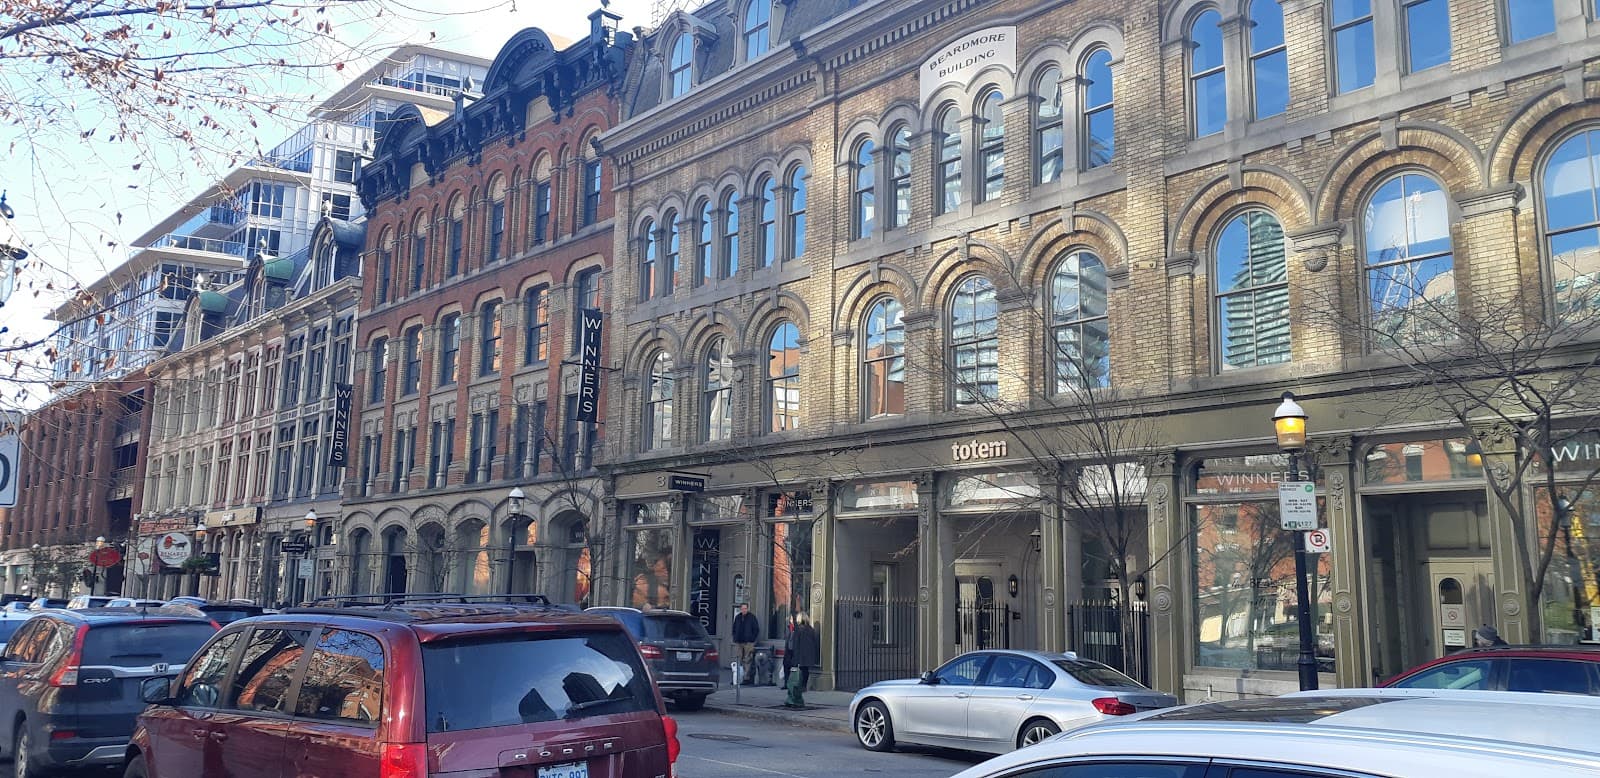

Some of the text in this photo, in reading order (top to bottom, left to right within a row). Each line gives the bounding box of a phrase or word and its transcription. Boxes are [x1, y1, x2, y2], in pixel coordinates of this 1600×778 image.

[929, 33, 1006, 71] BEARDMORE
[939, 49, 995, 78] BUILDING
[584, 316, 601, 413] WINNERS
[334, 389, 351, 461] WINNERS
[951, 439, 1008, 461] totem
[656, 474, 666, 488] 3
[674, 479, 703, 488] WINNERS
[697, 538, 714, 627] WINNERS
[514, 742, 613, 760] DODGE
